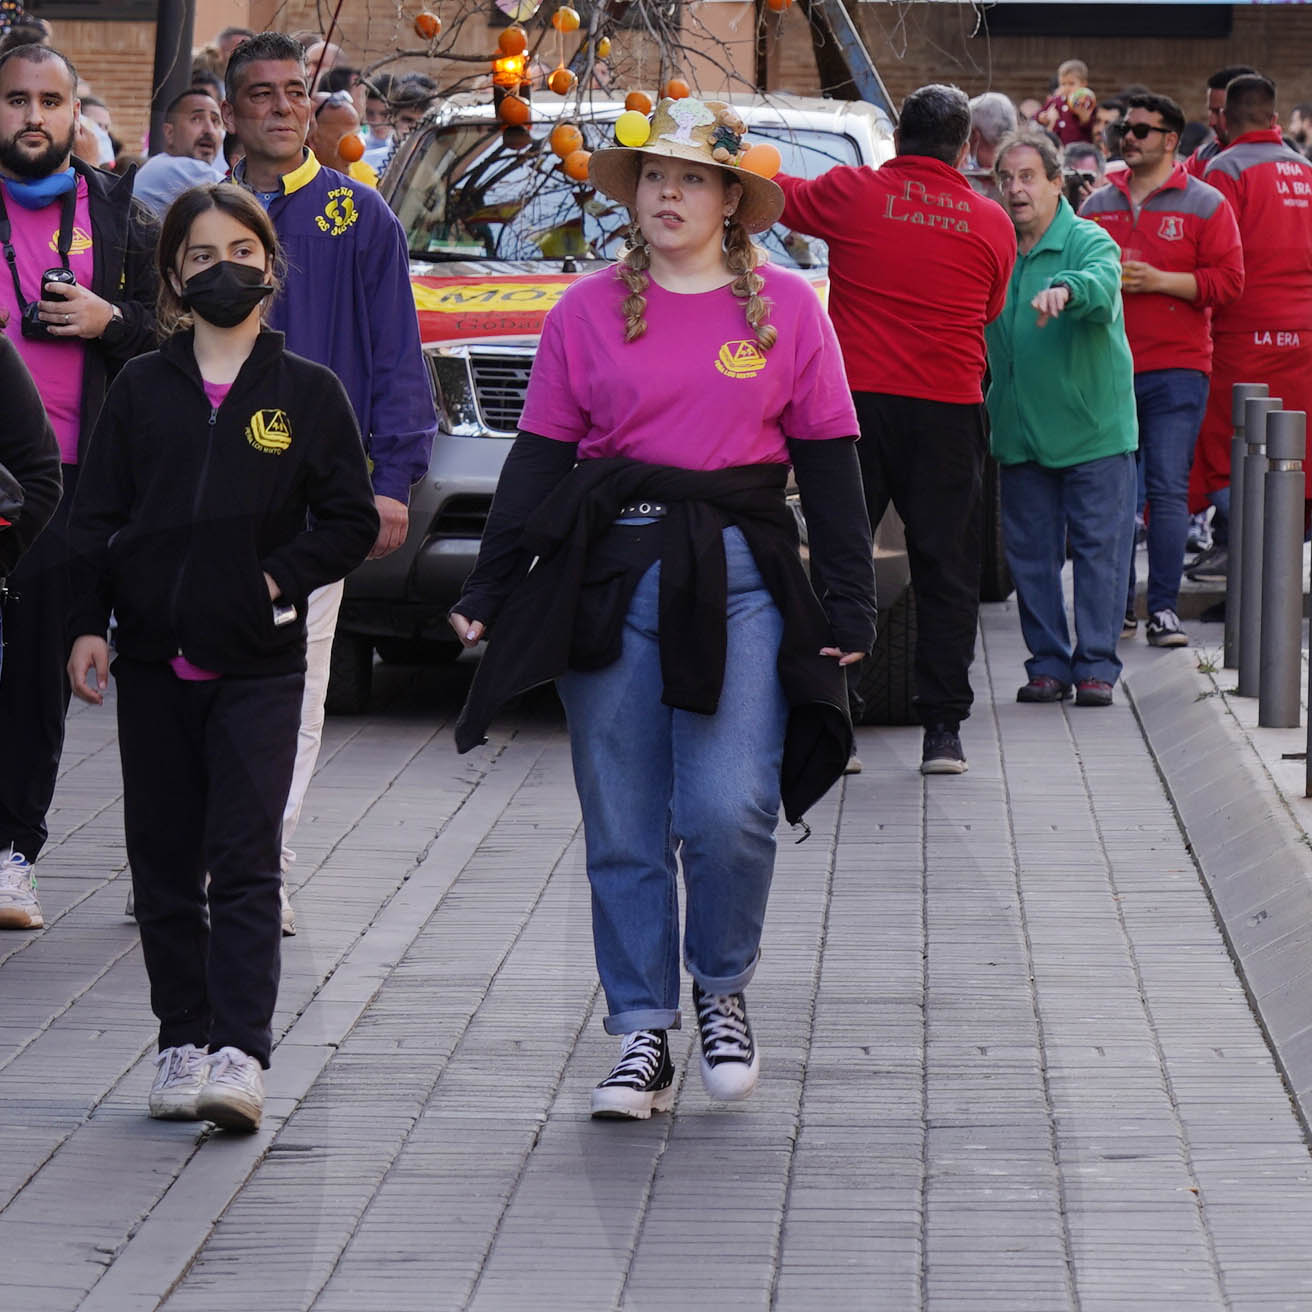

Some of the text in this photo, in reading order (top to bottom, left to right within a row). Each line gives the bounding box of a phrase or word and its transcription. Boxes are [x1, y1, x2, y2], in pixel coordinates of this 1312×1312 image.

[1275, 161, 1304, 176] PEÑA
[328, 186, 354, 200] PEÑA
[1276, 181, 1312, 195] LA ERA
[901, 180, 971, 213] Peña
[883, 193, 971, 233] Larra
[1254, 331, 1300, 347] LA ERA
